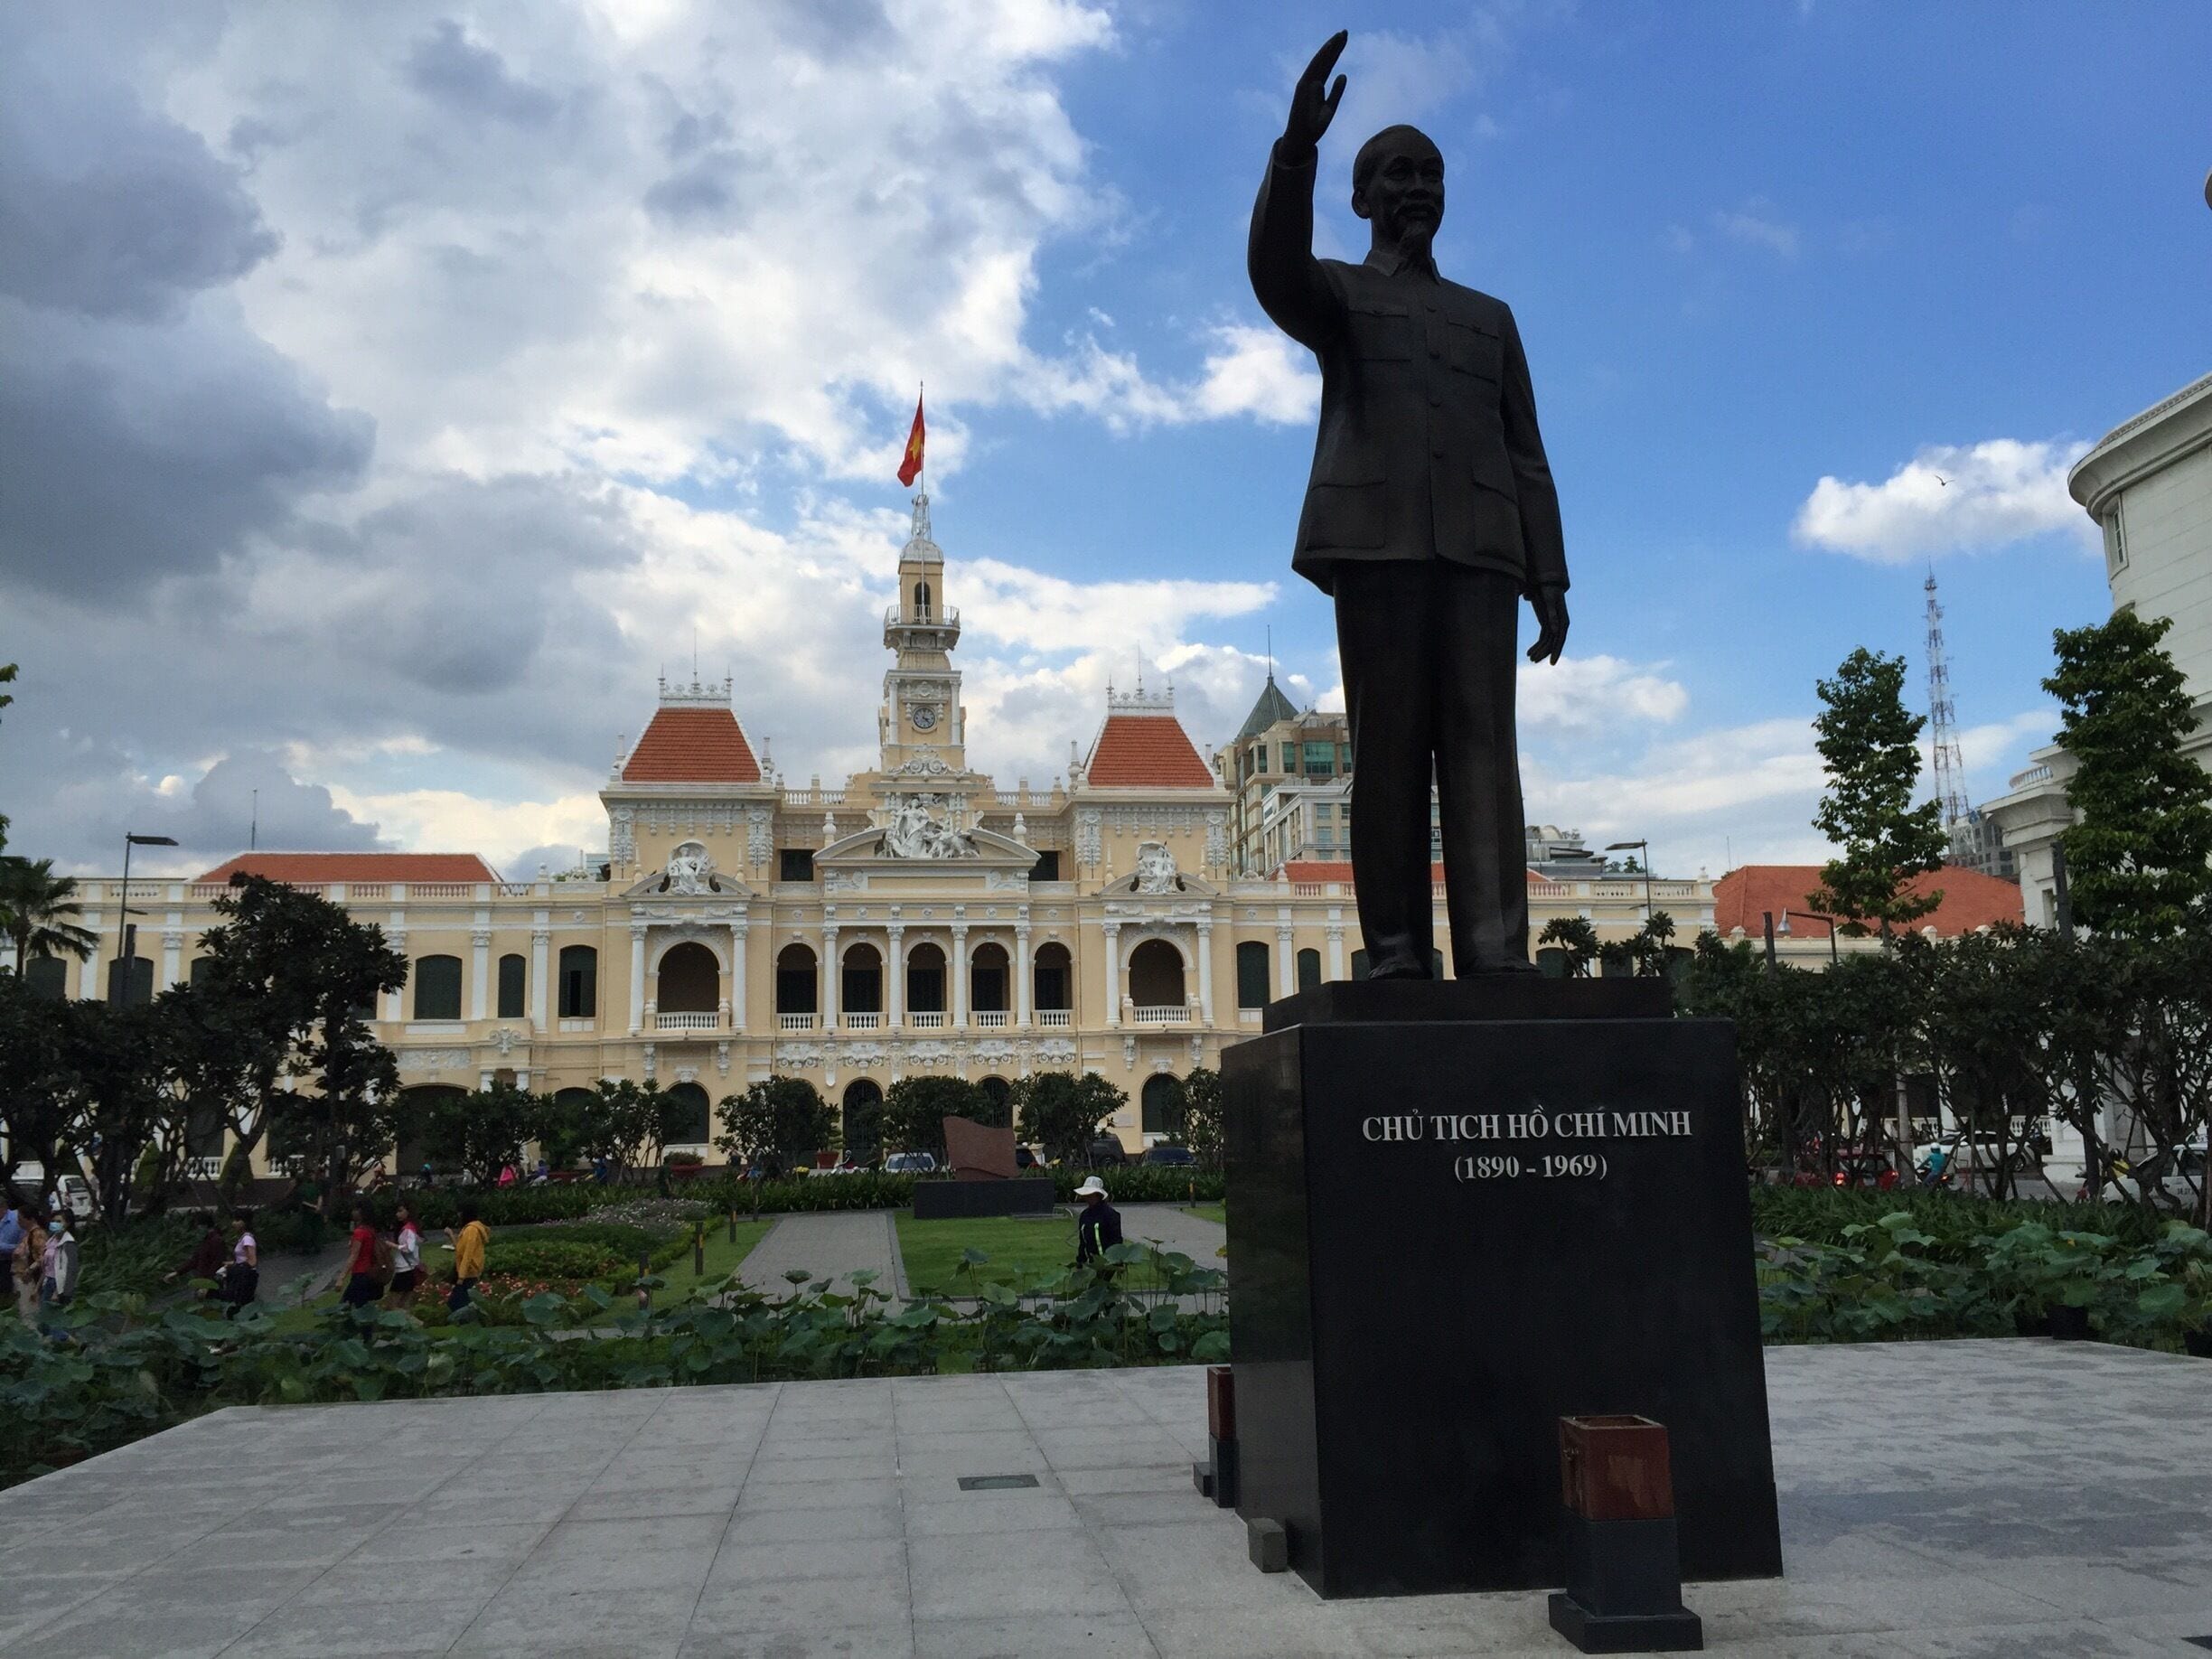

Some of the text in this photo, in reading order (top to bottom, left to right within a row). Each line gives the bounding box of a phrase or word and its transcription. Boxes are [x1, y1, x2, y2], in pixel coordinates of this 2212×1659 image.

[1362, 1103, 1693, 1144] CHỦ TỊCH HỒ CHÍ MINH
[1454, 1156, 1520, 1184] (1890
[1542, 1154, 1607, 1180] 1969)
